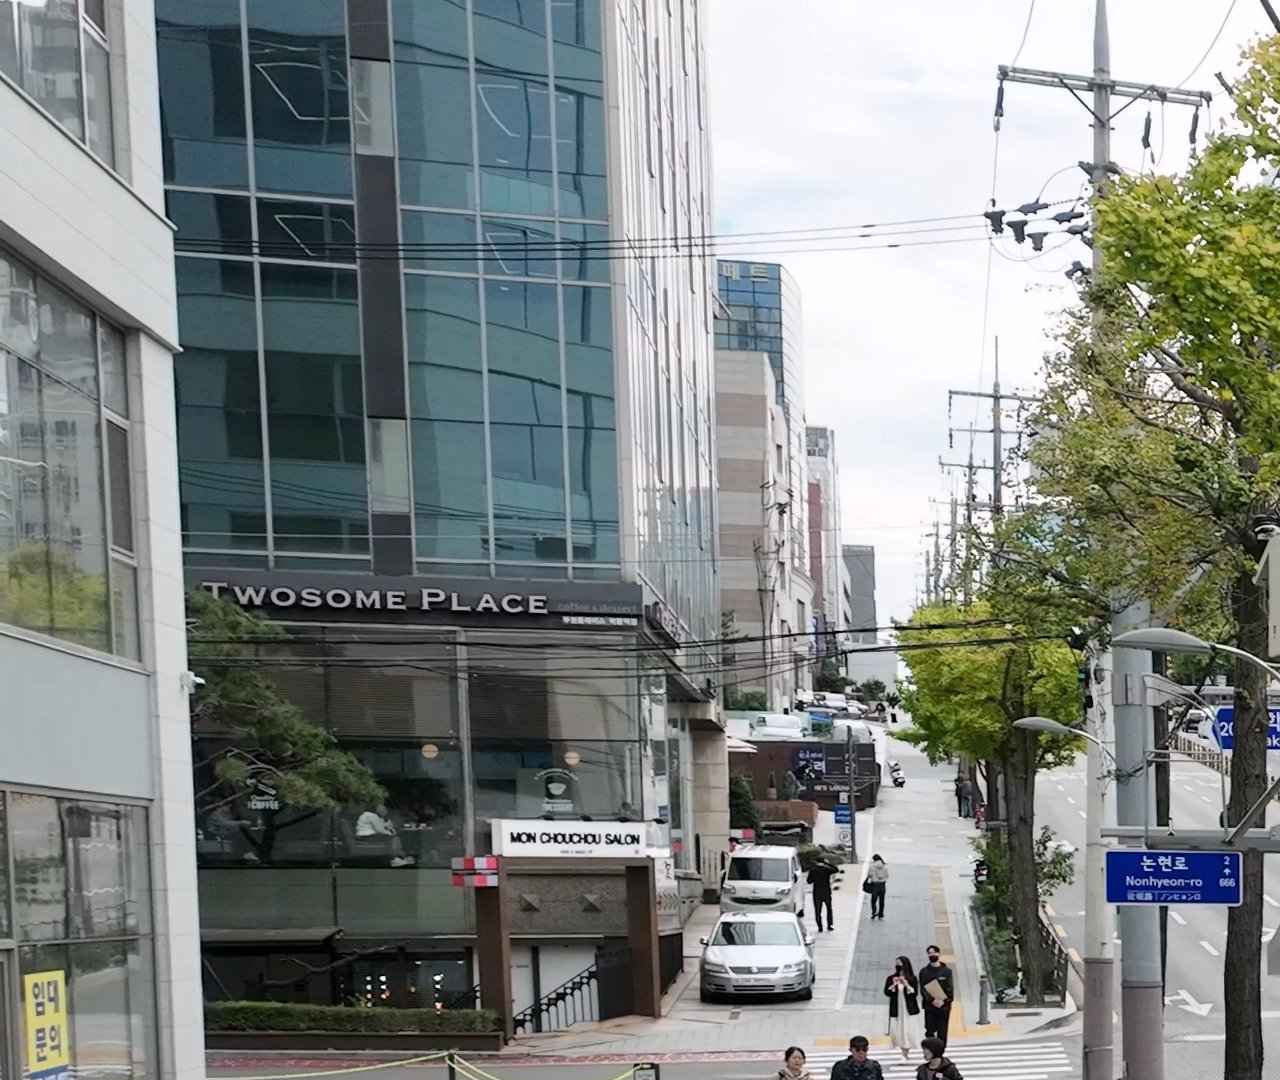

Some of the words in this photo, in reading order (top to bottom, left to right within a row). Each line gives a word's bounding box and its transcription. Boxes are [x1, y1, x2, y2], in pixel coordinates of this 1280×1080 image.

[203, 581, 406, 611] TWOSOME
[419, 587, 548, 614] PLACE
[510, 832, 536, 844] MON
[540, 832, 601, 845] CHOUCHOU
[605, 833, 640, 845] SALON
[1141, 855, 1188, 872] 논현로
[1223, 856, 1231, 865] 2
[1125, 875, 1203, 888] Nonhyeon-ro
[32, 980, 59, 1016] 임대
[35, 1024, 62, 1062] 문의
